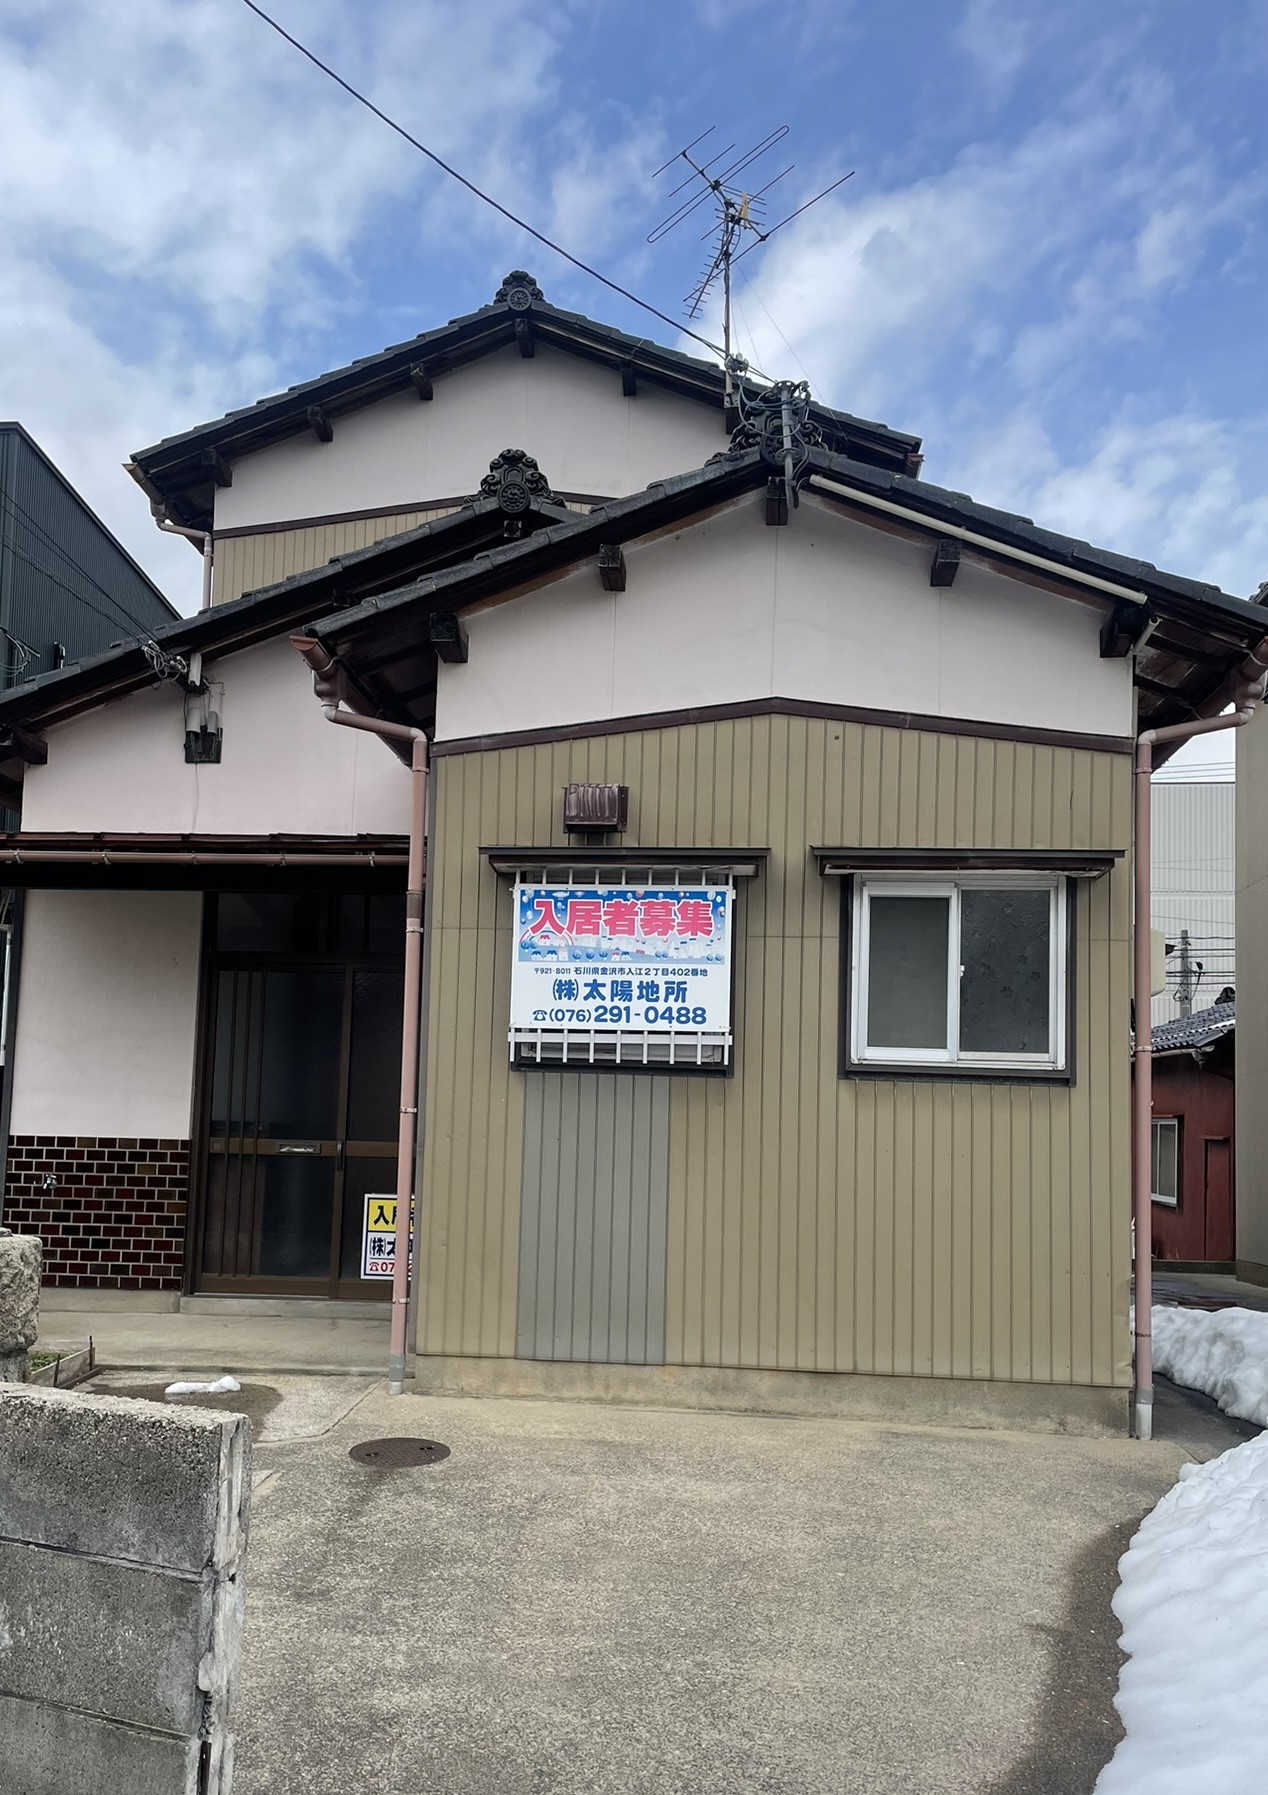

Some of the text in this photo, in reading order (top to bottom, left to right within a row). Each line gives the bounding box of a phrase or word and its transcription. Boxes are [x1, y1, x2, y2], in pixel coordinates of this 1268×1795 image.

[529, 899, 714, 937] 入居者募集
[574, 967, 708, 977] 石川県金沢市入江2丁目402番地
[553, 979, 688, 1003] (株)太陽地所
[549, 1005, 707, 1025] (076)291-0488
